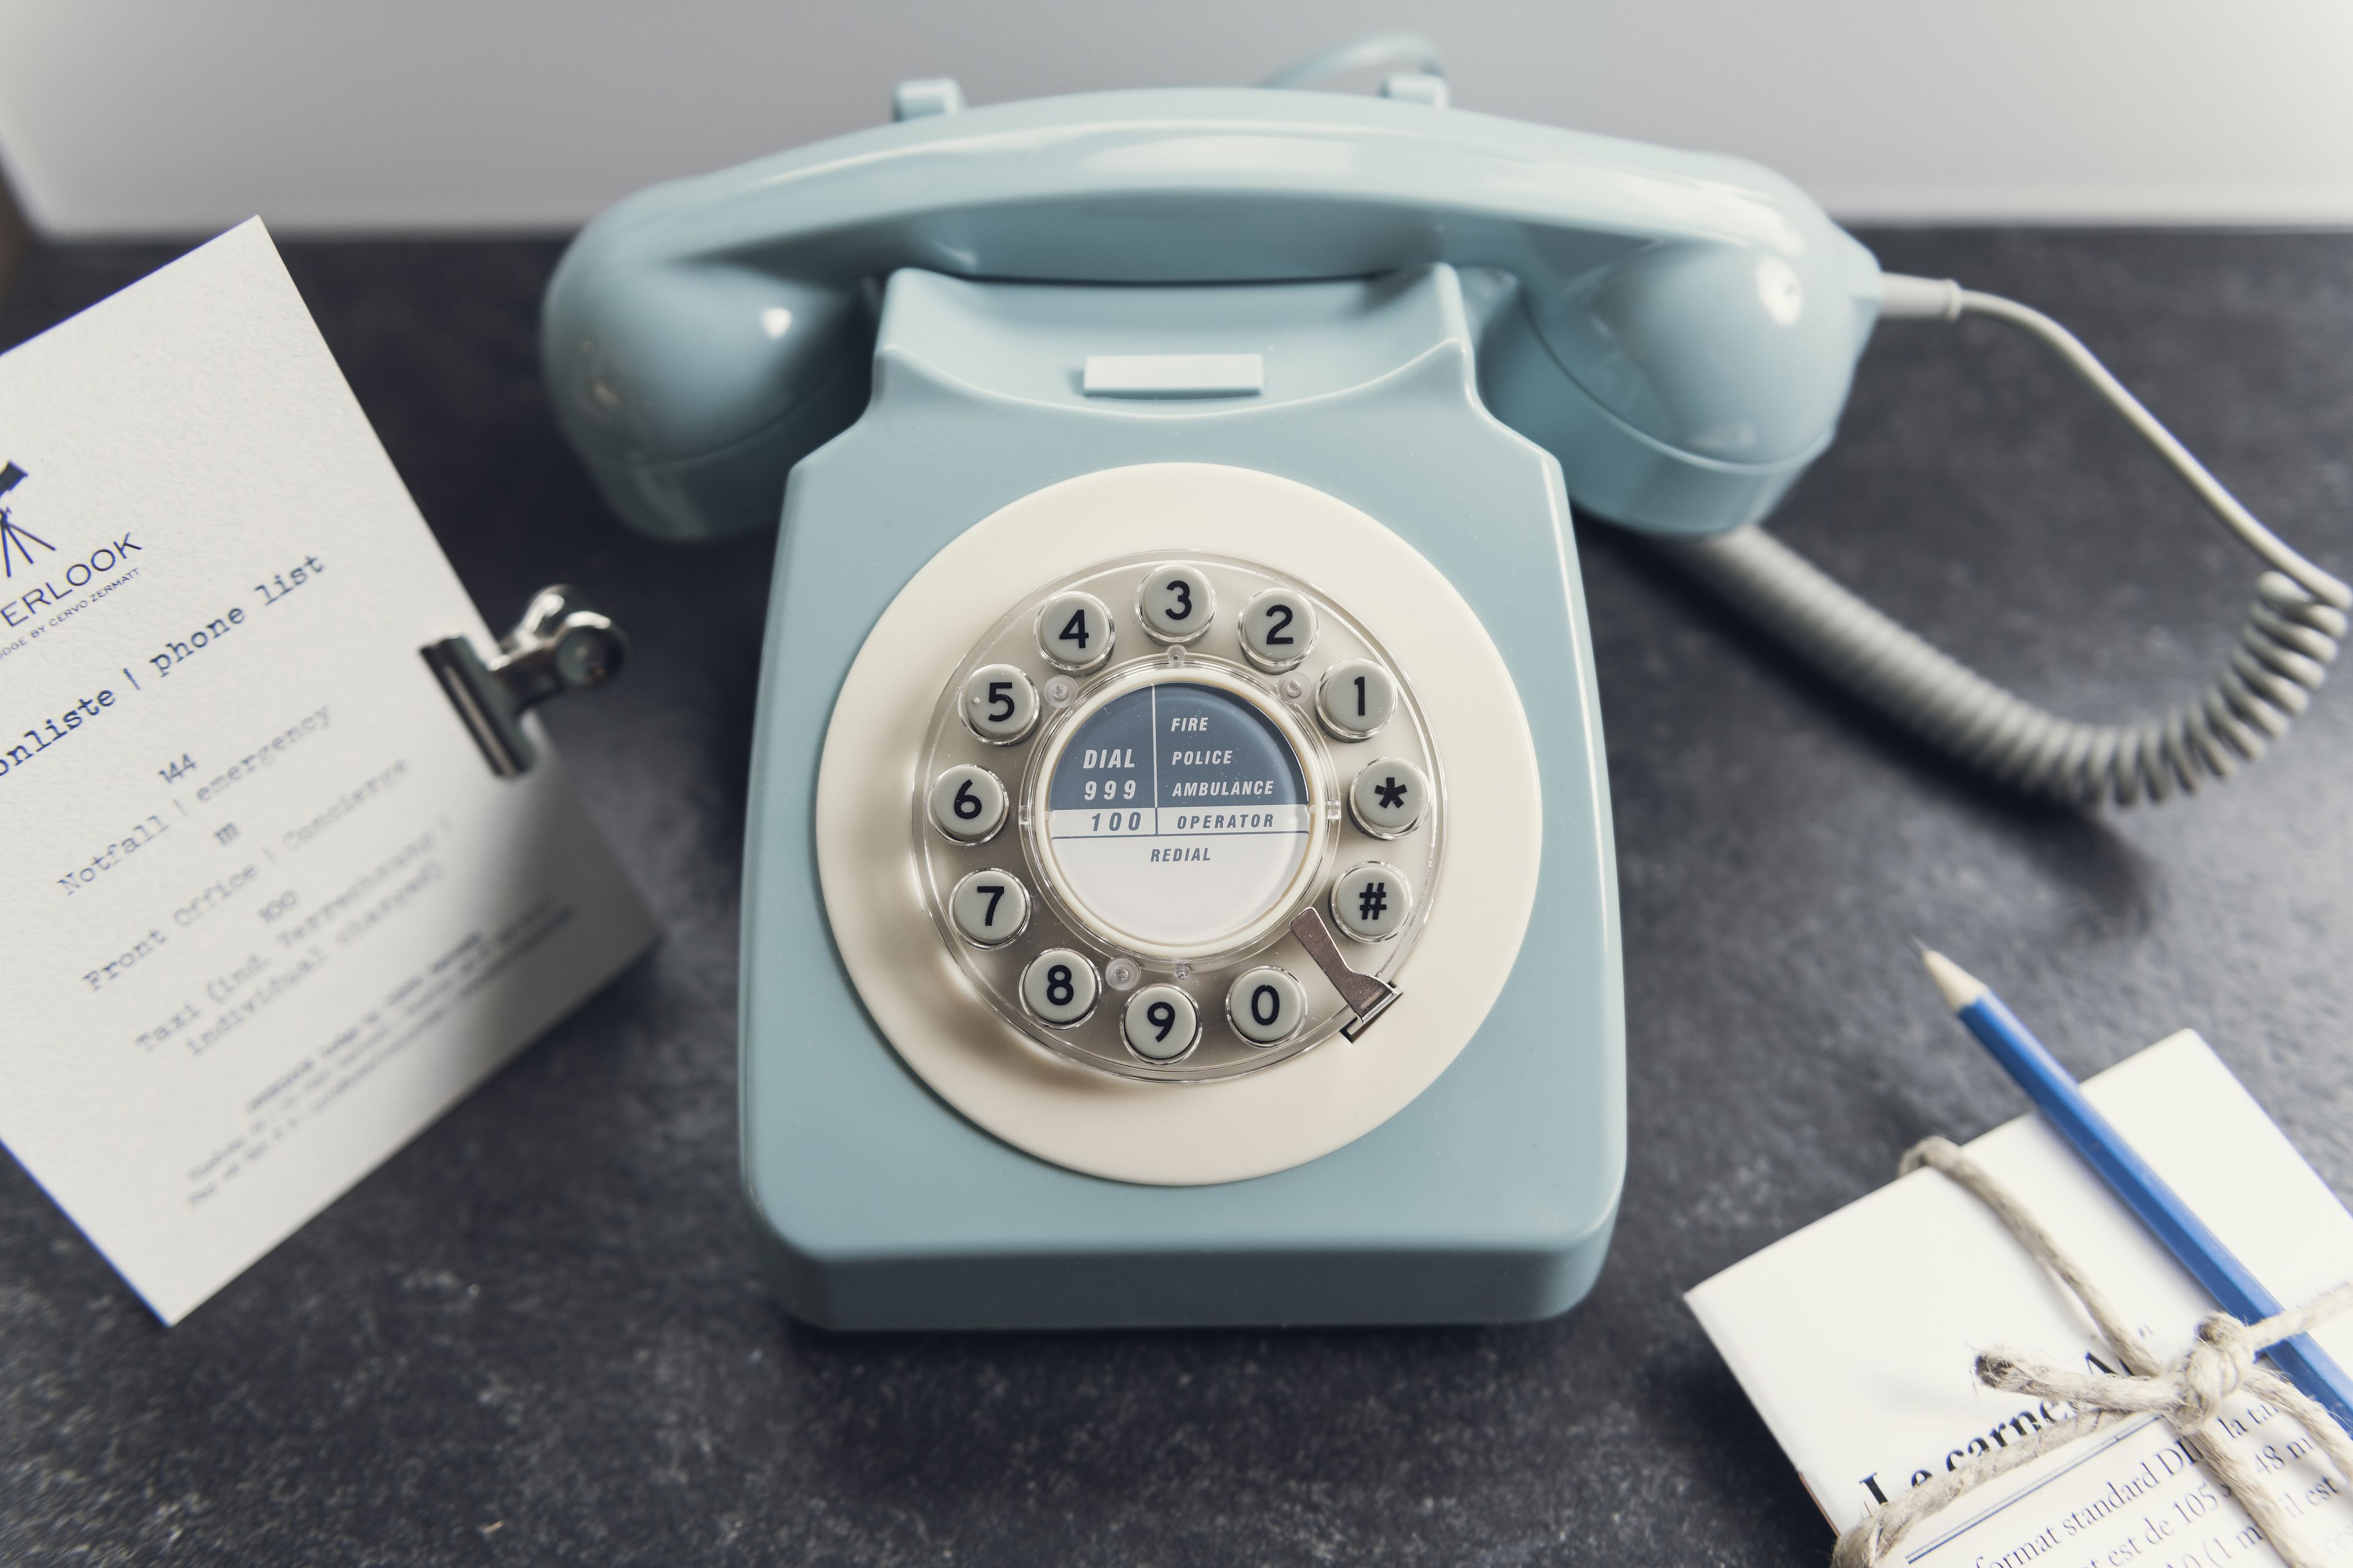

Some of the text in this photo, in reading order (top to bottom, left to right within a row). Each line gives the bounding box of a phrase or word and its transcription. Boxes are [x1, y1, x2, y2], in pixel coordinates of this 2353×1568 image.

[31, 625, 46, 638] BY
[49, 600, 88, 627] CERVO
[89, 567, 140, 603] ZERMATT
[150, 607, 246, 677] phone
[254, 555, 324, 605] list
[1165, 581, 1192, 620] 3
[1059, 610, 1089, 648] 4
[1267, 605, 1293, 645] 2
[988, 682, 1014, 722] 5
[1355, 676, 1365, 716] 1
[1171, 717, 1208, 732] FIRE
[159, 753, 196, 784] 144
[1083, 749, 1135, 769] DIAL
[1172, 750, 1233, 765] POLICE
[57, 815, 169, 896] Notfall
[197, 706, 329, 801] emergency
[954, 779, 982, 819] 6
[1084, 779, 1136, 801] 999
[1172, 780, 1274, 797] AMBULANCE
[1091, 811, 1142, 831] 100
[1177, 814, 1273, 830] OPERATOR
[1150, 847, 1211, 862] REDIAL
[977, 886, 1004, 926] 7
[83, 928, 167, 991] Front
[173, 863, 257, 926] Office
[1047, 965, 1074, 1006] 8
[1251, 985, 1279, 1025] 0
[135, 1002, 202, 1052] Taxi
[1147, 1002, 1175, 1042] 9
[2063, 1461, 2161, 1536] standard
[2216, 1416, 2248, 1439] la
[2305, 1475, 2340, 1506] est
[2109, 1536, 2143, 1567] est
[2143, 1517, 2174, 1545] de
[2173, 1480, 2218, 1524] 105
